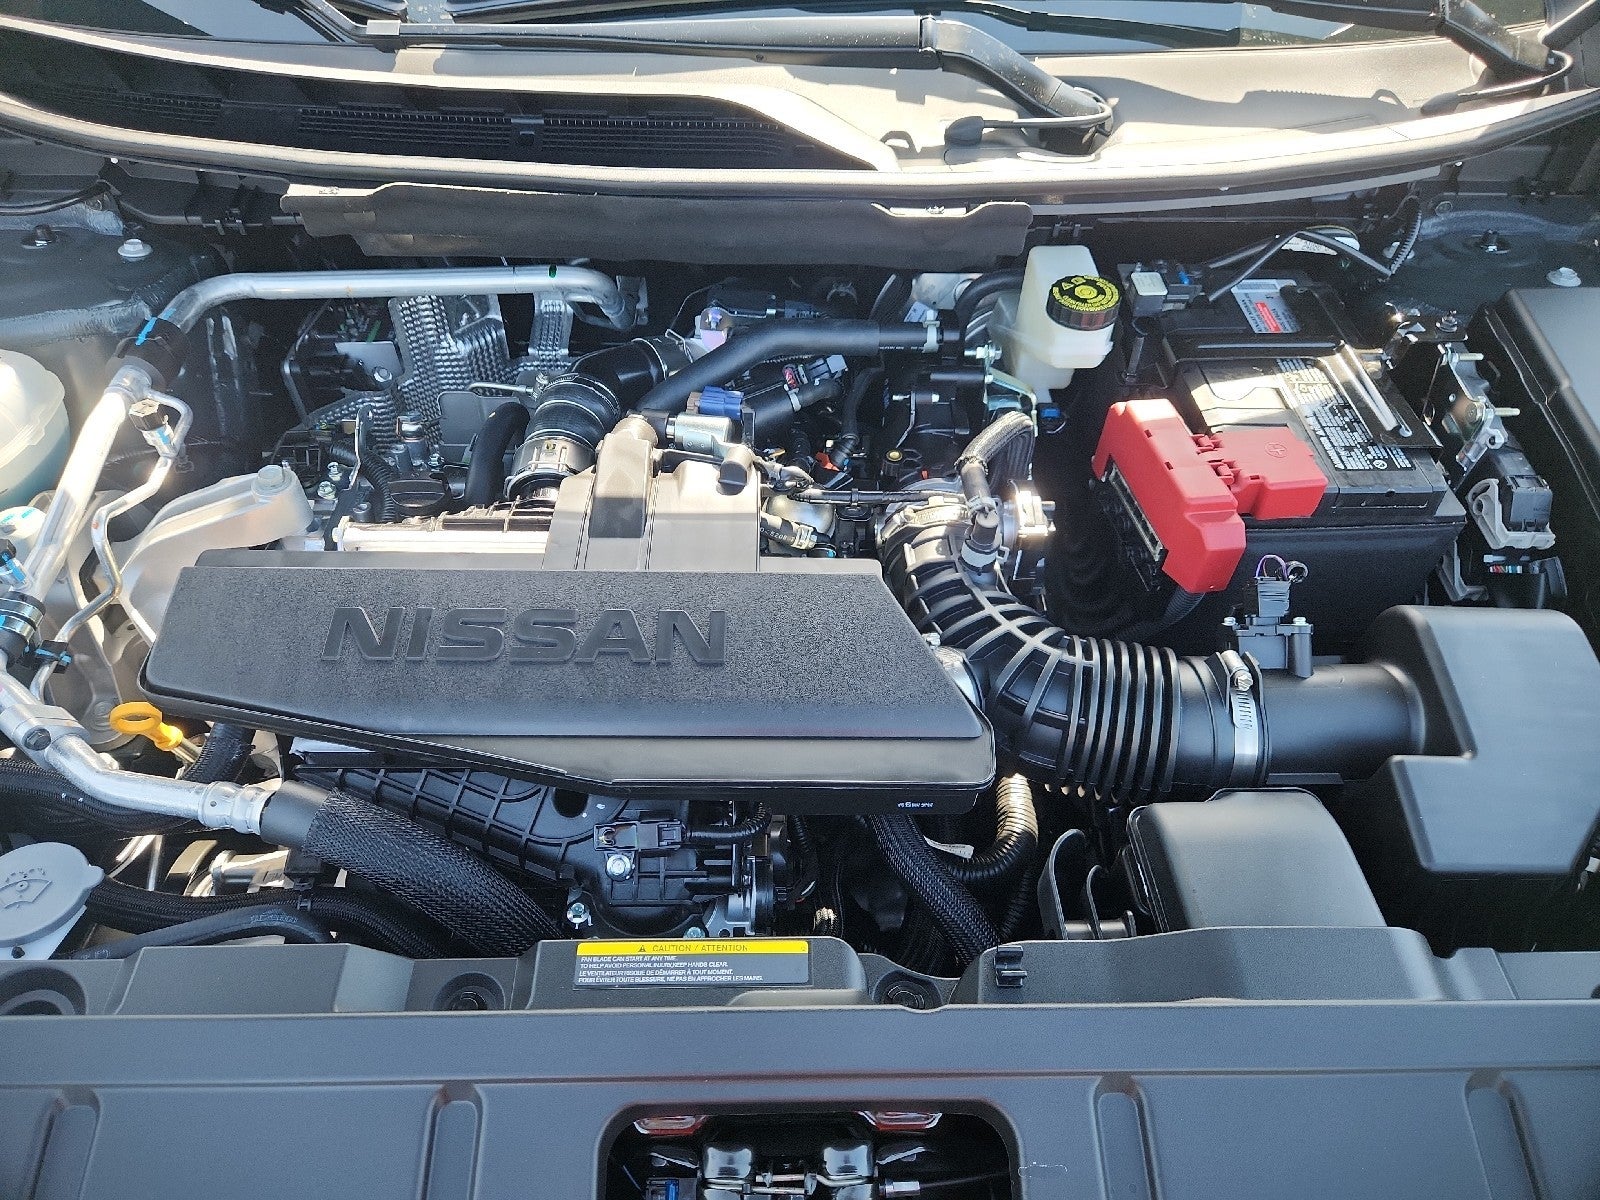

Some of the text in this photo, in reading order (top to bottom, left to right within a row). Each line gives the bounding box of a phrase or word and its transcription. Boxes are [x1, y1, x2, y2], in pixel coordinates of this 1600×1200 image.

[321, 606, 727, 665] NISSAN
[652, 944, 692, 952] CAUTION
[701, 944, 748, 952] ATTENTION
